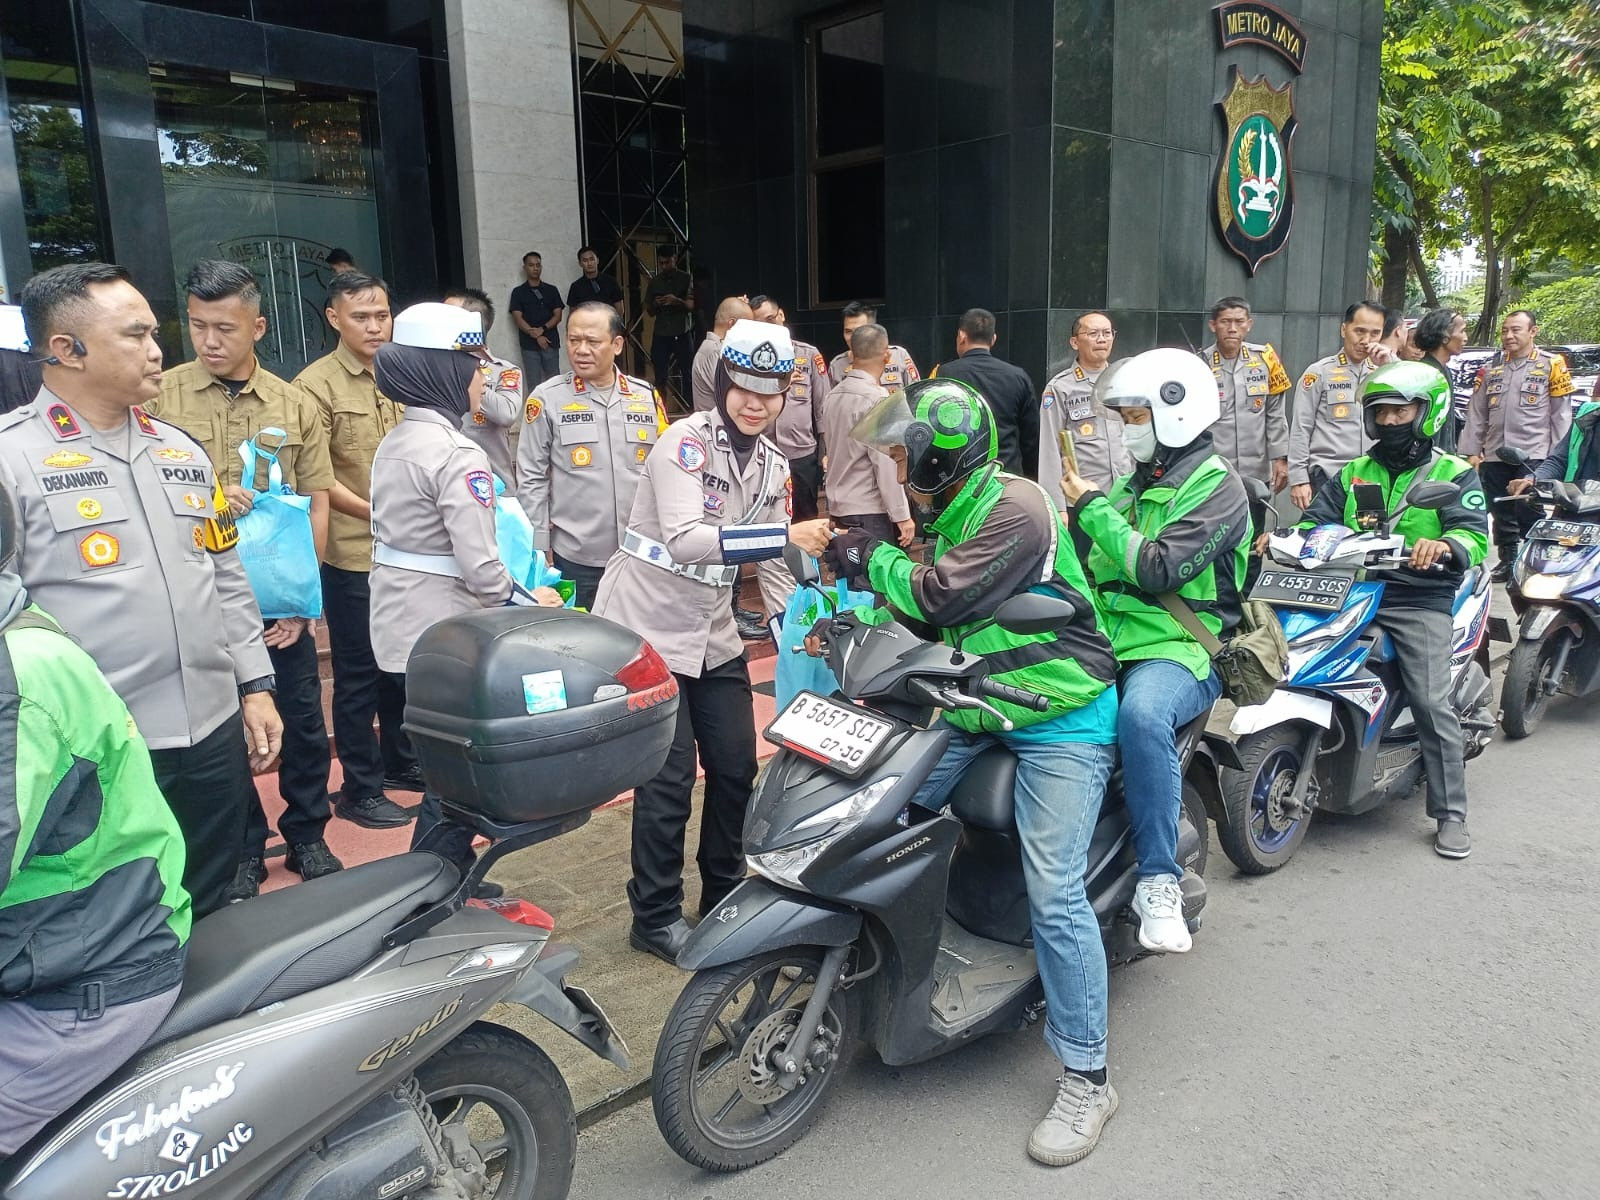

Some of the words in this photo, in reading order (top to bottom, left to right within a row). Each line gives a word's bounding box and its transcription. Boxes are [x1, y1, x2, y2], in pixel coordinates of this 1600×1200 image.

[1227, 12, 1270, 36] METRO
[1272, 22, 1300, 59] JAYA
[290, 245, 328, 261] AYA
[626, 414, 654, 424] POLRI
[42, 470, 109, 492] DEKANANTO
[162, 467, 206, 484] POLRI
[1536, 521, 1546, 529] B
[1193, 523, 1230, 566] gojek
[979, 534, 1024, 587] gojek
[1262, 575, 1273, 586] B
[1278, 576, 1313, 590] 4553
[1317, 579, 1346, 593] SCS
[1326, 658, 1351, 678] HONDA
[791, 698, 808, 715] B
[806, 702, 850, 729] 5657
[846, 718, 882, 743] SCI
[885, 836, 932, 864] HONDA
[172, 1132, 190, 1157] &
[107, 1122, 254, 1199] STROLLING
